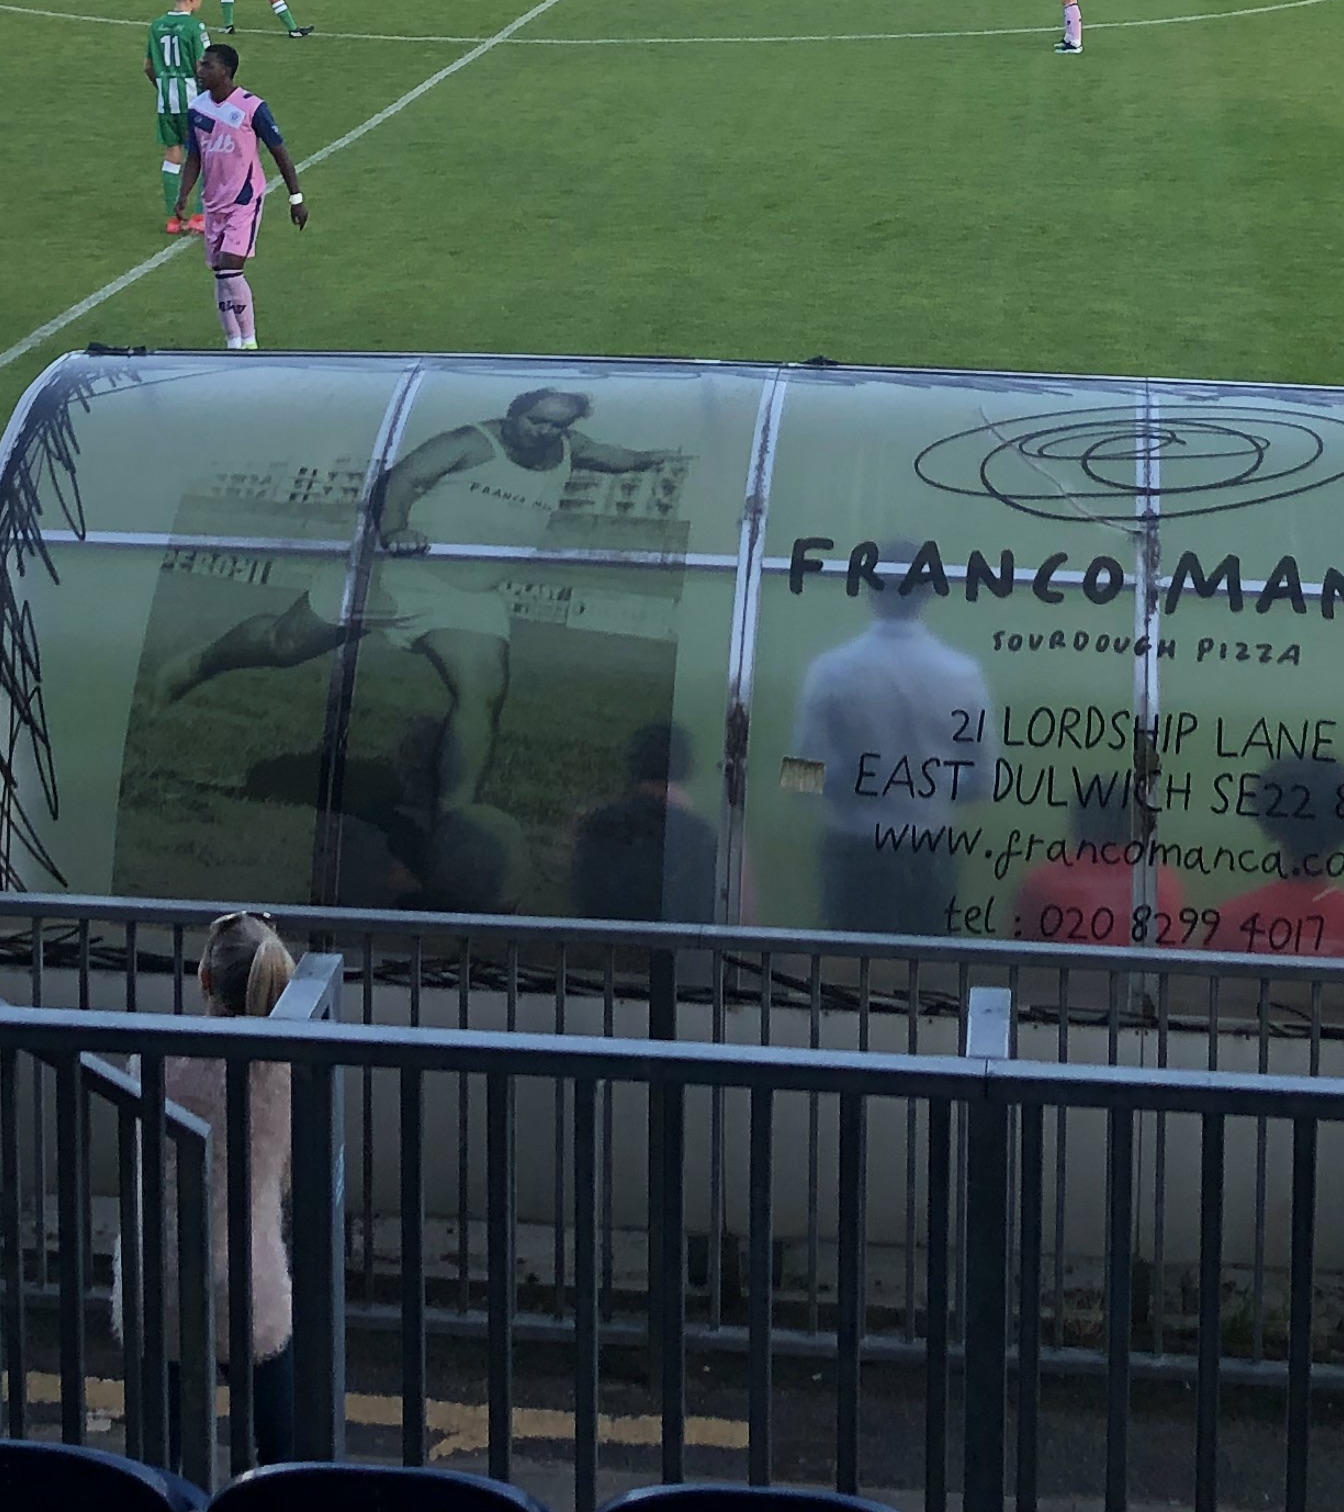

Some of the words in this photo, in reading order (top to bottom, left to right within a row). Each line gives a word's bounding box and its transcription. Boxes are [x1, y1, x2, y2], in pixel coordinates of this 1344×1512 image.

[160, 35, 181, 67] 11
[788, 536, 1126, 606] FRANCO
[992, 630, 1176, 659] SOURDOUGH
[1198, 638, 1302, 667] PIZZA
[951, 708, 986, 744] 21
[1003, 705, 1199, 756] LORDSHIP
[1215, 718, 1338, 764] LANE
[855, 753, 976, 801] EAST
[993, 757, 1192, 814] DULWICH
[1209, 773, 1317, 821] SE22
[945, 895, 997, 937] tel
[1039, 905, 1115, 940] 020
[1131, 906, 1223, 944] 8299
[1240, 914, 1326, 951] 4017
